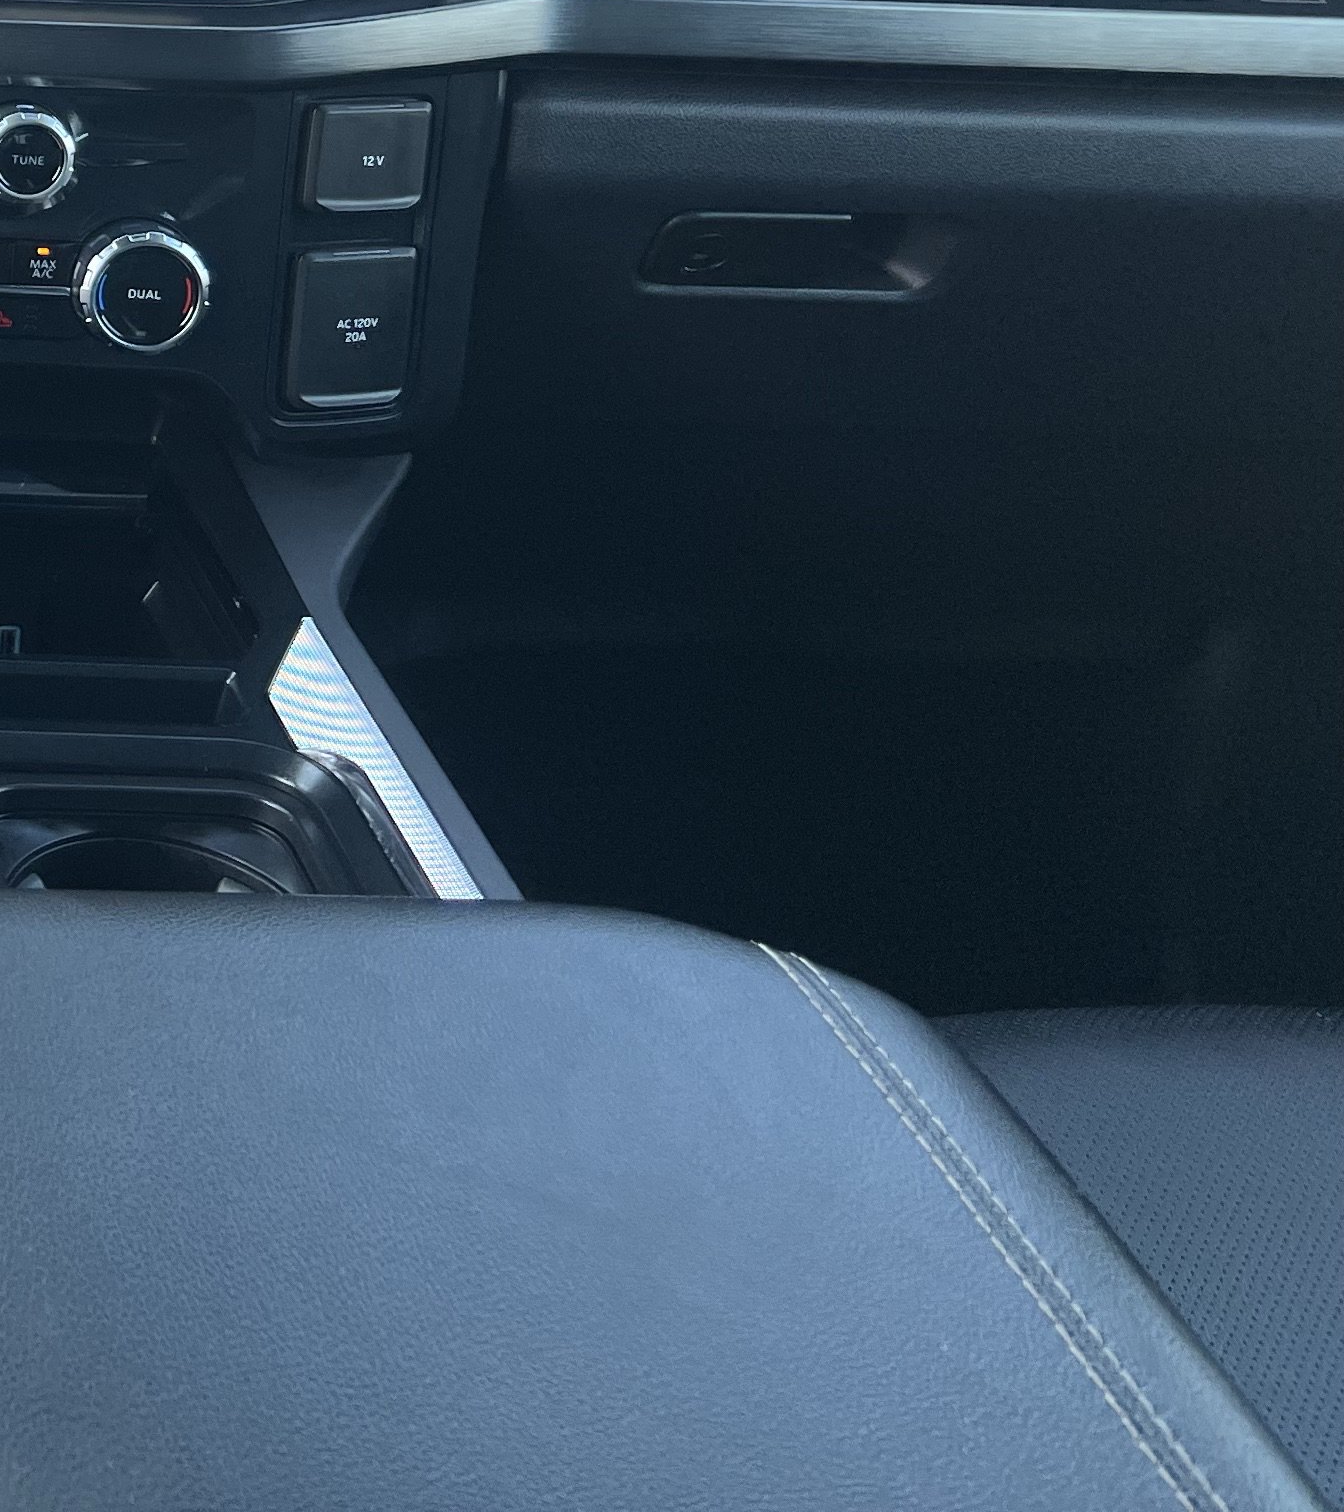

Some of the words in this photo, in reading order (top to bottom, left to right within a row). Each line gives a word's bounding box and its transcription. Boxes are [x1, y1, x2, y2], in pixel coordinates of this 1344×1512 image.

[12, 154, 45, 166] TUNE
[29, 259, 57, 271] MAX
[31, 268, 55, 280] A/C
[127, 288, 162, 301] DUAL
[336, 318, 352, 330] AC
[344, 331, 367, 343] 20A
